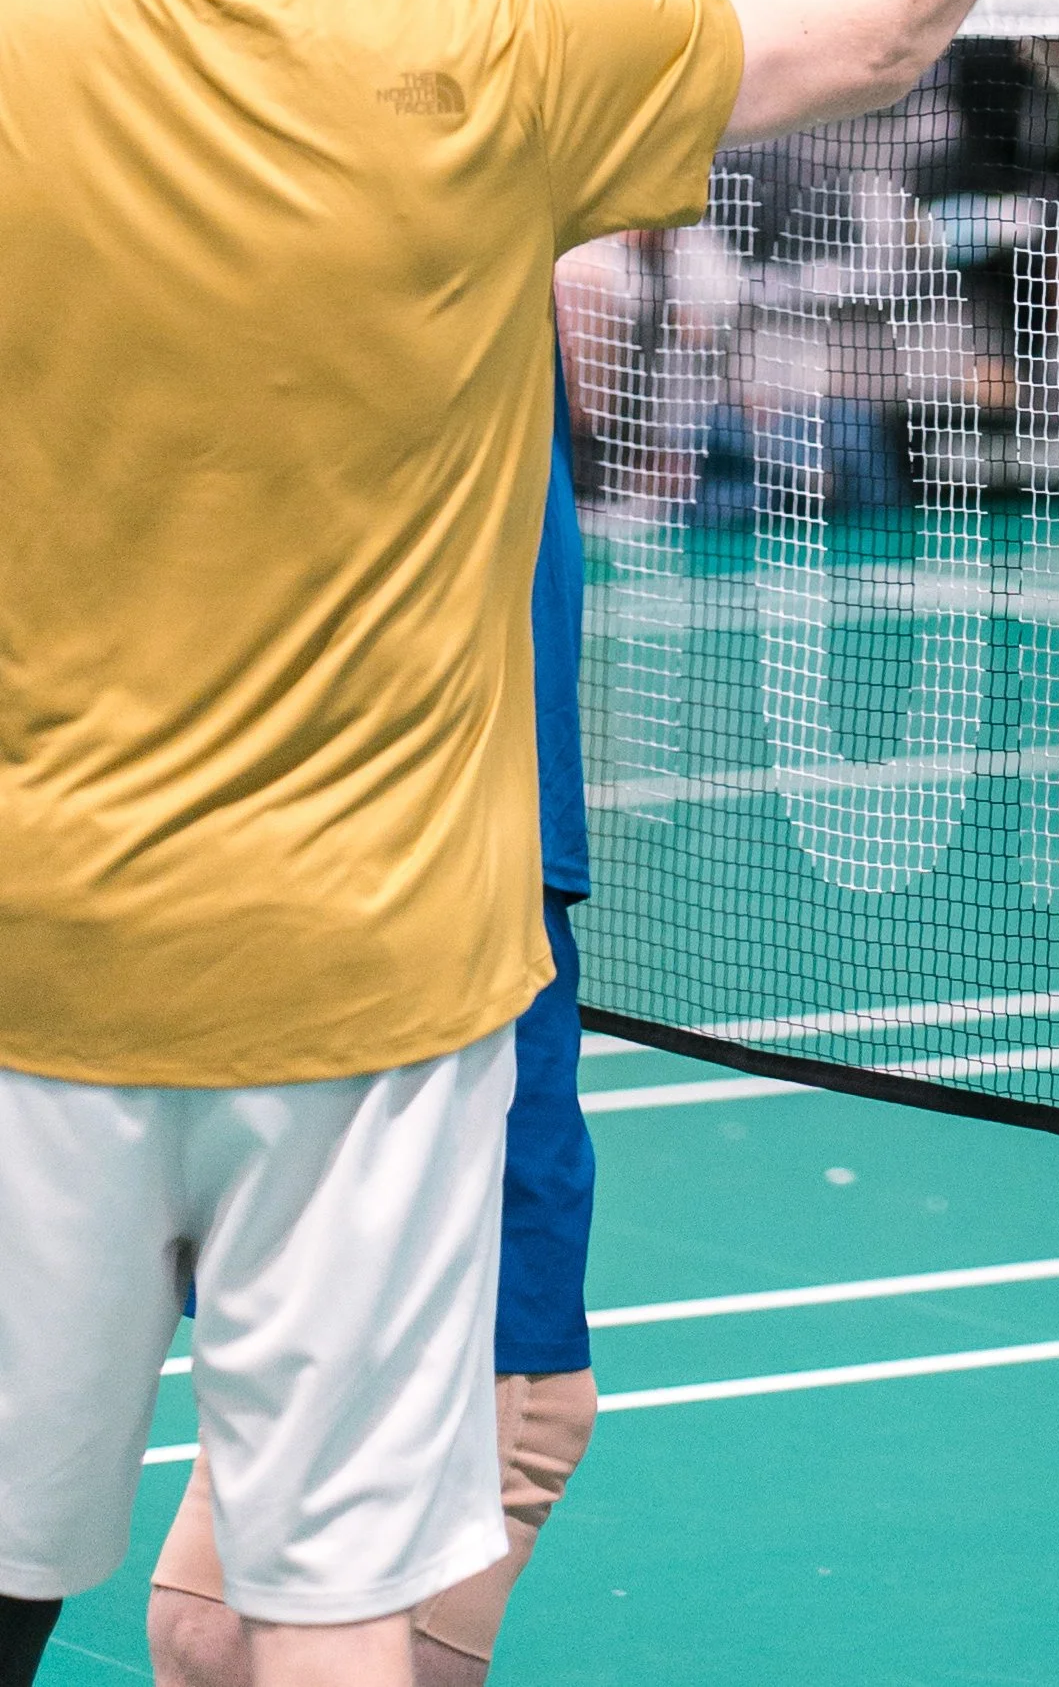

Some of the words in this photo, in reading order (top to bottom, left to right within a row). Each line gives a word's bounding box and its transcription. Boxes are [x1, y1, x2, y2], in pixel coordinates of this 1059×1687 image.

[401, 72, 438, 89] THE
[376, 87, 438, 103] NORTH
[395, 100, 438, 115] FACE
